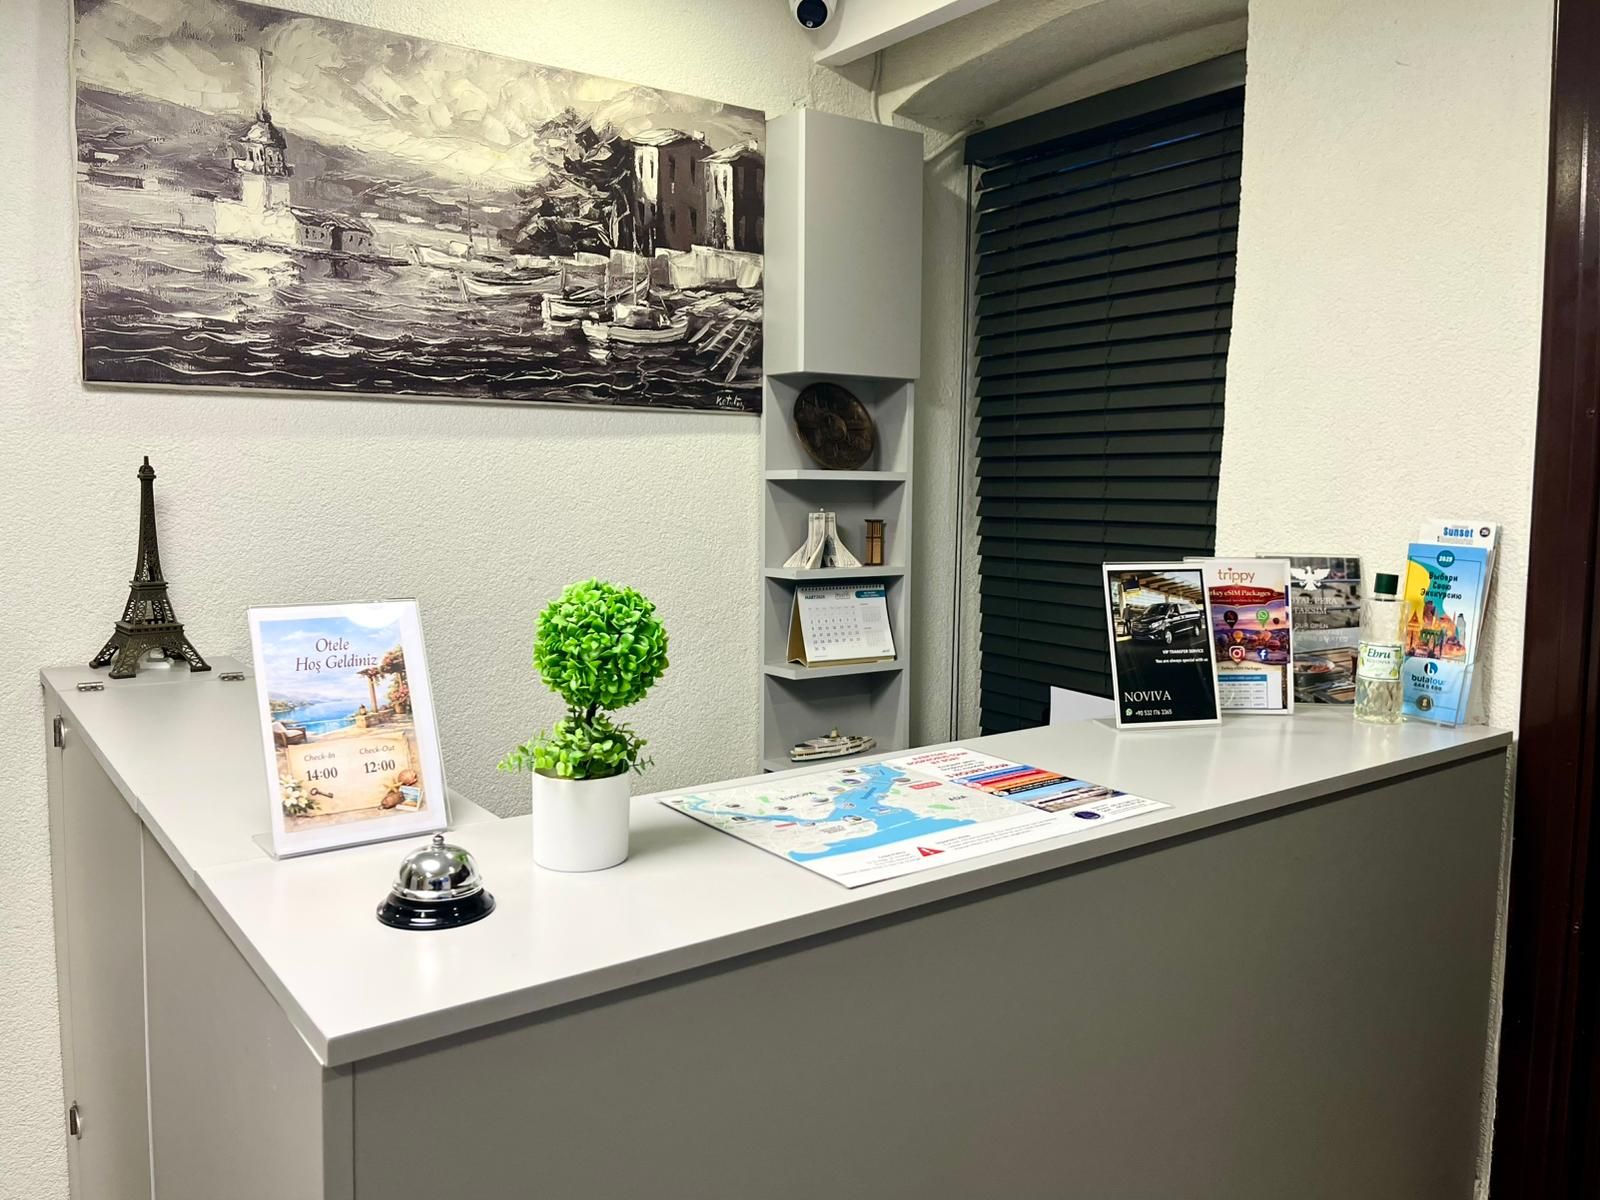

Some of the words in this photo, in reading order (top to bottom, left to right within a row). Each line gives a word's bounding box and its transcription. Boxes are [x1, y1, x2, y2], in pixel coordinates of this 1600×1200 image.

[1443, 527, 1474, 538] Sunset
[1218, 567, 1255, 583] trippy
[1429, 572, 1458, 583] Выбери
[1208, 589, 1223, 597] rkey
[1241, 589, 1271, 597] Packages
[315, 637, 350, 653] Otele
[1367, 647, 1392, 659] Ebru
[296, 656, 321, 673] Hoş
[325, 653, 378, 669] Geldiniz
[1411, 674, 1446, 686] butatou
[1124, 690, 1172, 703] NOVIVA
[360, 745, 395, 755] Check-Out
[304, 752, 336, 762] Check-In
[364, 759, 396, 774] 12:00
[306, 766, 338, 781] 14:00
